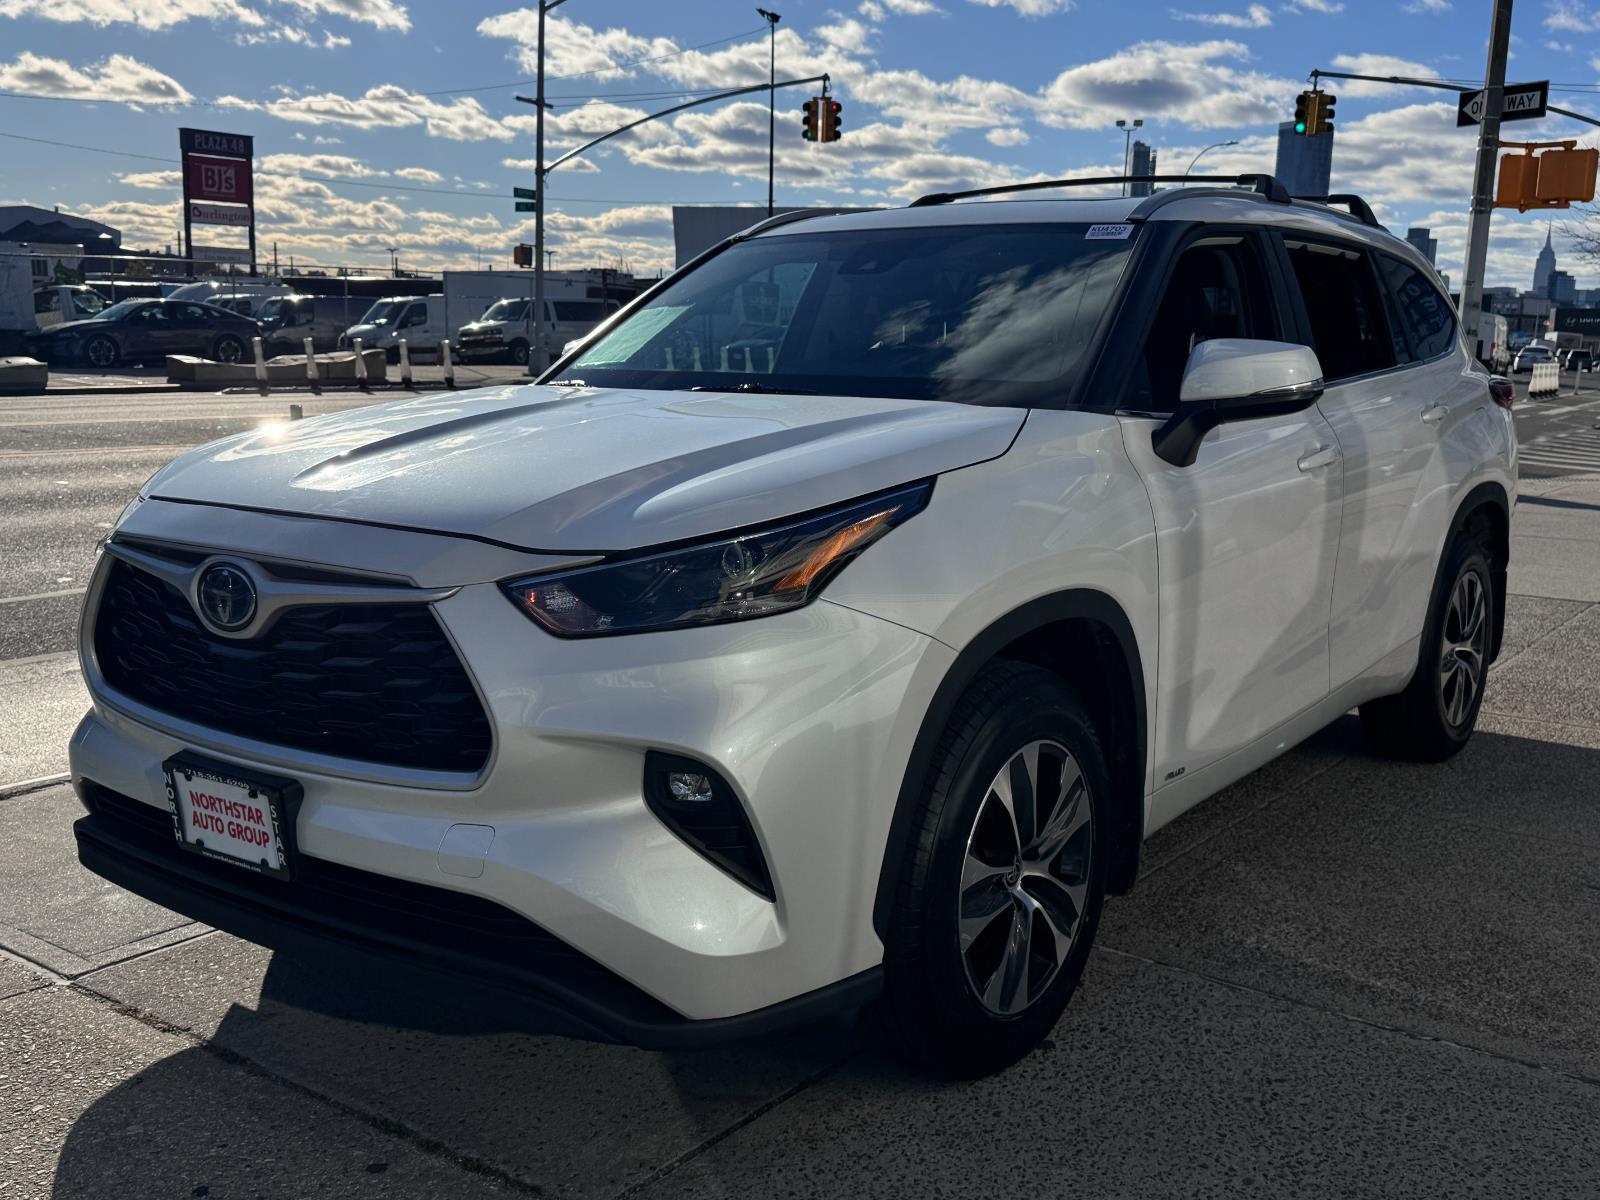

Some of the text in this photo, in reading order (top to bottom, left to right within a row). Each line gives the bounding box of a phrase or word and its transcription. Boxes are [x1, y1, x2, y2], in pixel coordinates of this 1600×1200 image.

[1507, 93, 1536, 110] WAY
[194, 134, 229, 152] PLAZA
[192, 206, 250, 223] Burlington
[163, 772, 183, 842] NORTH
[189, 790, 265, 827] NORTHSTAR
[192, 811, 270, 848] AUTO GROUP
[270, 805, 287, 866] STAR
